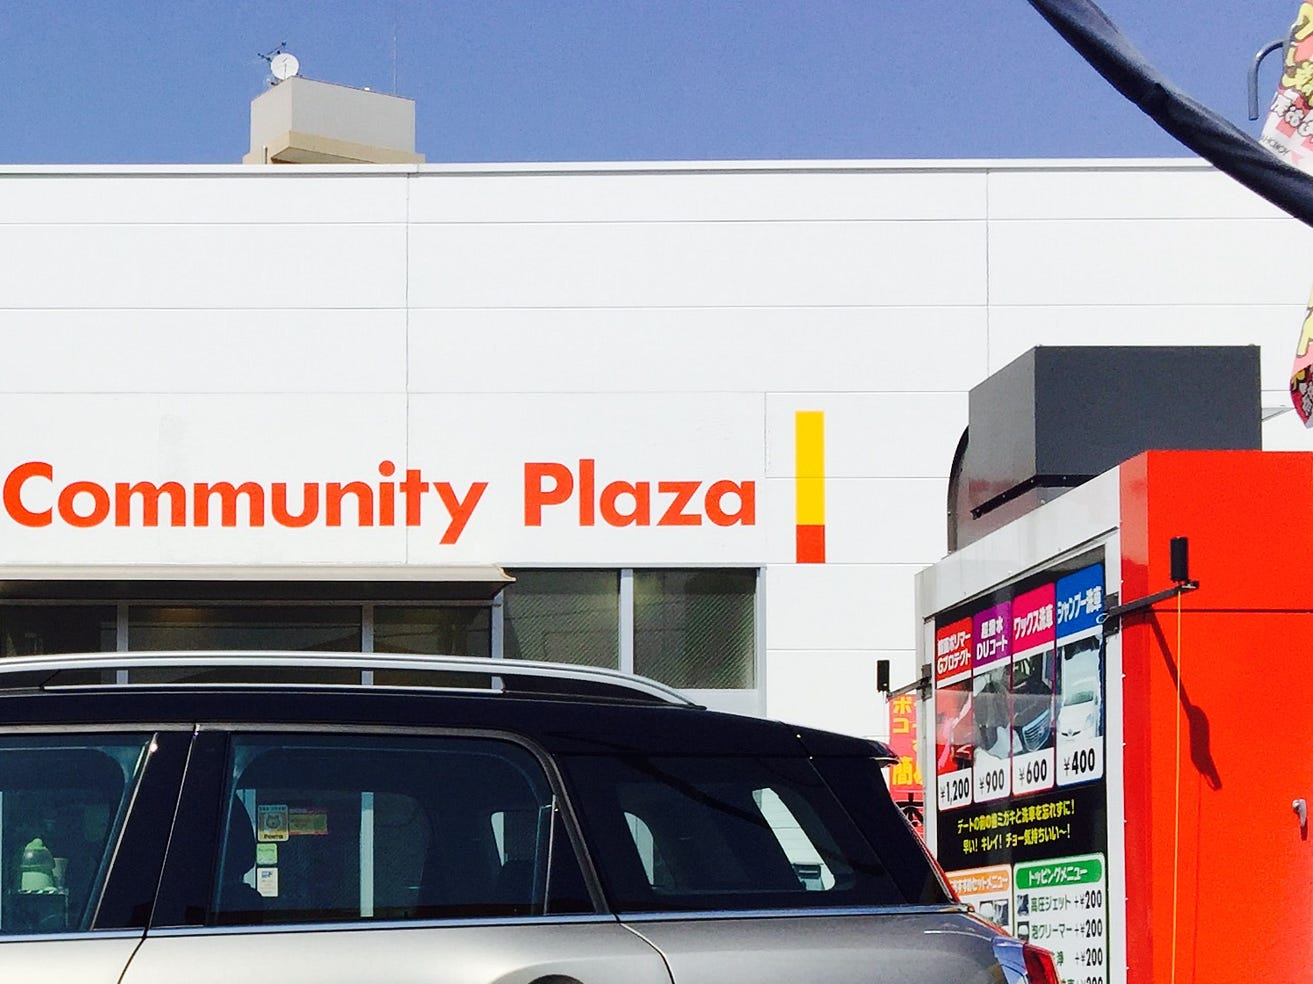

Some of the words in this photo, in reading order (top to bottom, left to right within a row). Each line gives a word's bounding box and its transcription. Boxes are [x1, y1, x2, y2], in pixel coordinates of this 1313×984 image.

[3, 460, 488, 545] Community
[524, 460, 756, 528] Plaza
[1014, 604, 1053, 640] ワックス洗車
[1019, 759, 1047, 785] ¥600
[1064, 748, 1096, 775] ¥400
[940, 777, 970, 805] ¥1,200
[979, 769, 1005, 795] ¥900
[1029, 866, 1088, 887] トッピングメニュー
